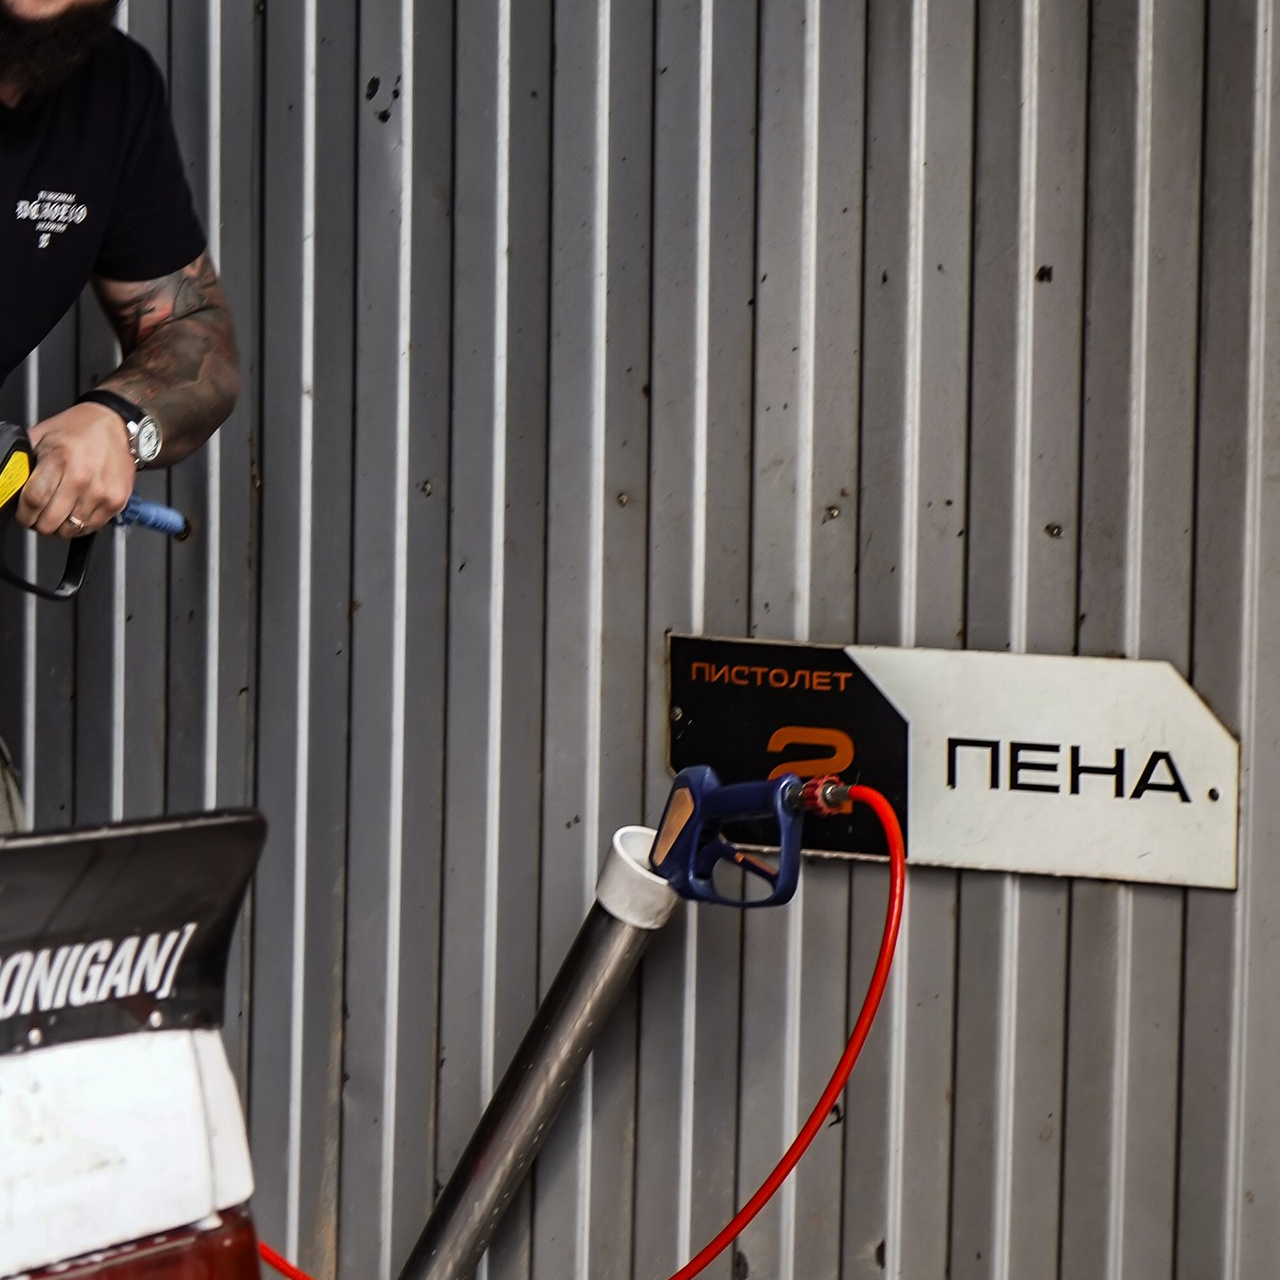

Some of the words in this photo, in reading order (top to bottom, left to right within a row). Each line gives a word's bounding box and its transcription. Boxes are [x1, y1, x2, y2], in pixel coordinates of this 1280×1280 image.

[691, 661, 853, 692] ПИСТОЛЕТ
[767, 725, 855, 814] 2
[946, 737, 1192, 803] ПЕНА
